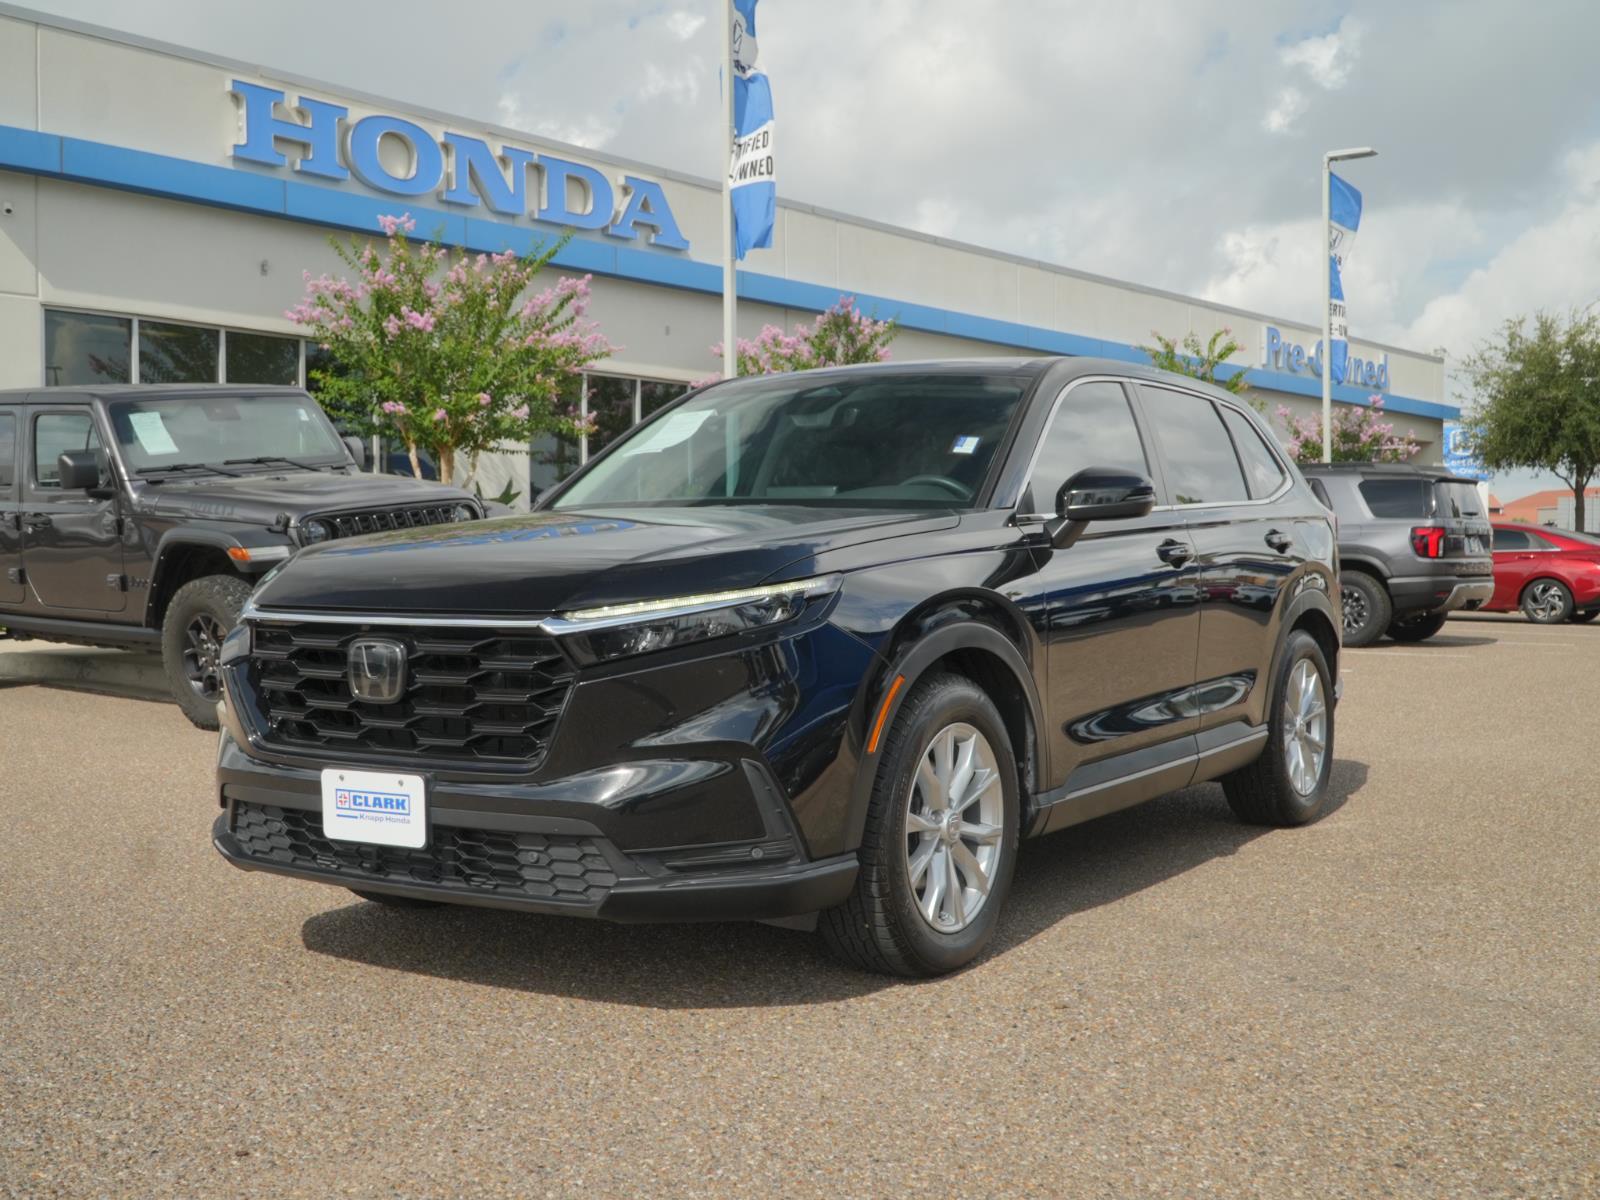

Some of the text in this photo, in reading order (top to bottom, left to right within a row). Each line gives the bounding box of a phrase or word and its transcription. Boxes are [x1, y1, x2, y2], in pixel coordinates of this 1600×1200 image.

[226, 78, 690, 251] HONDA
[1266, 326, 1388, 389] Pre-Oned
[352, 794, 406, 811] CLARK
[385, 815, 411, 825] Honda
